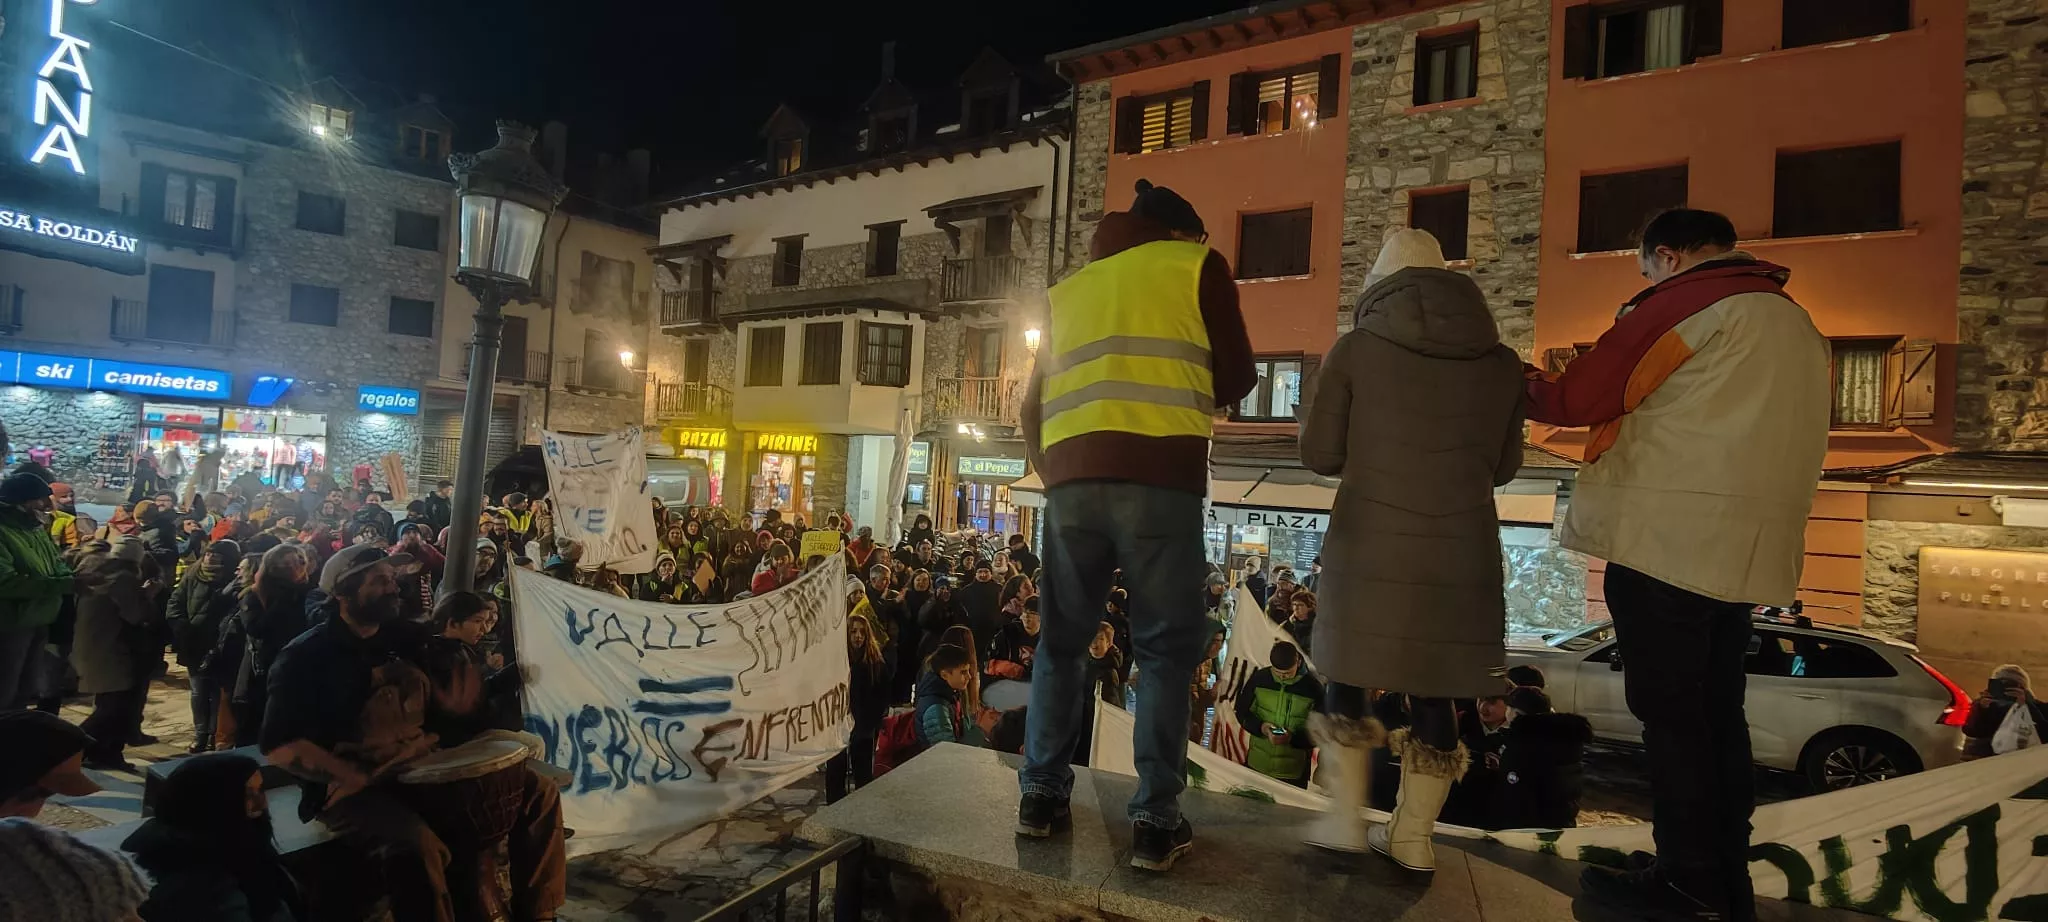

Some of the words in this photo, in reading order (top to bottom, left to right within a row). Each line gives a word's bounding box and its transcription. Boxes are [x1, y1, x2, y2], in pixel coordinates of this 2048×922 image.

[30, 0, 96, 175] LANA
[37, 219, 138, 252] ROLDÁN
[35, 363, 75, 380] ski
[105, 371, 219, 392] camisetas
[360, 393, 416, 408] regalos
[975, 462, 984, 472] el
[985, 462, 1010, 474] Pepe
[1248, 513, 1317, 530] PLAZA
[564, 600, 718, 658] VALLE
